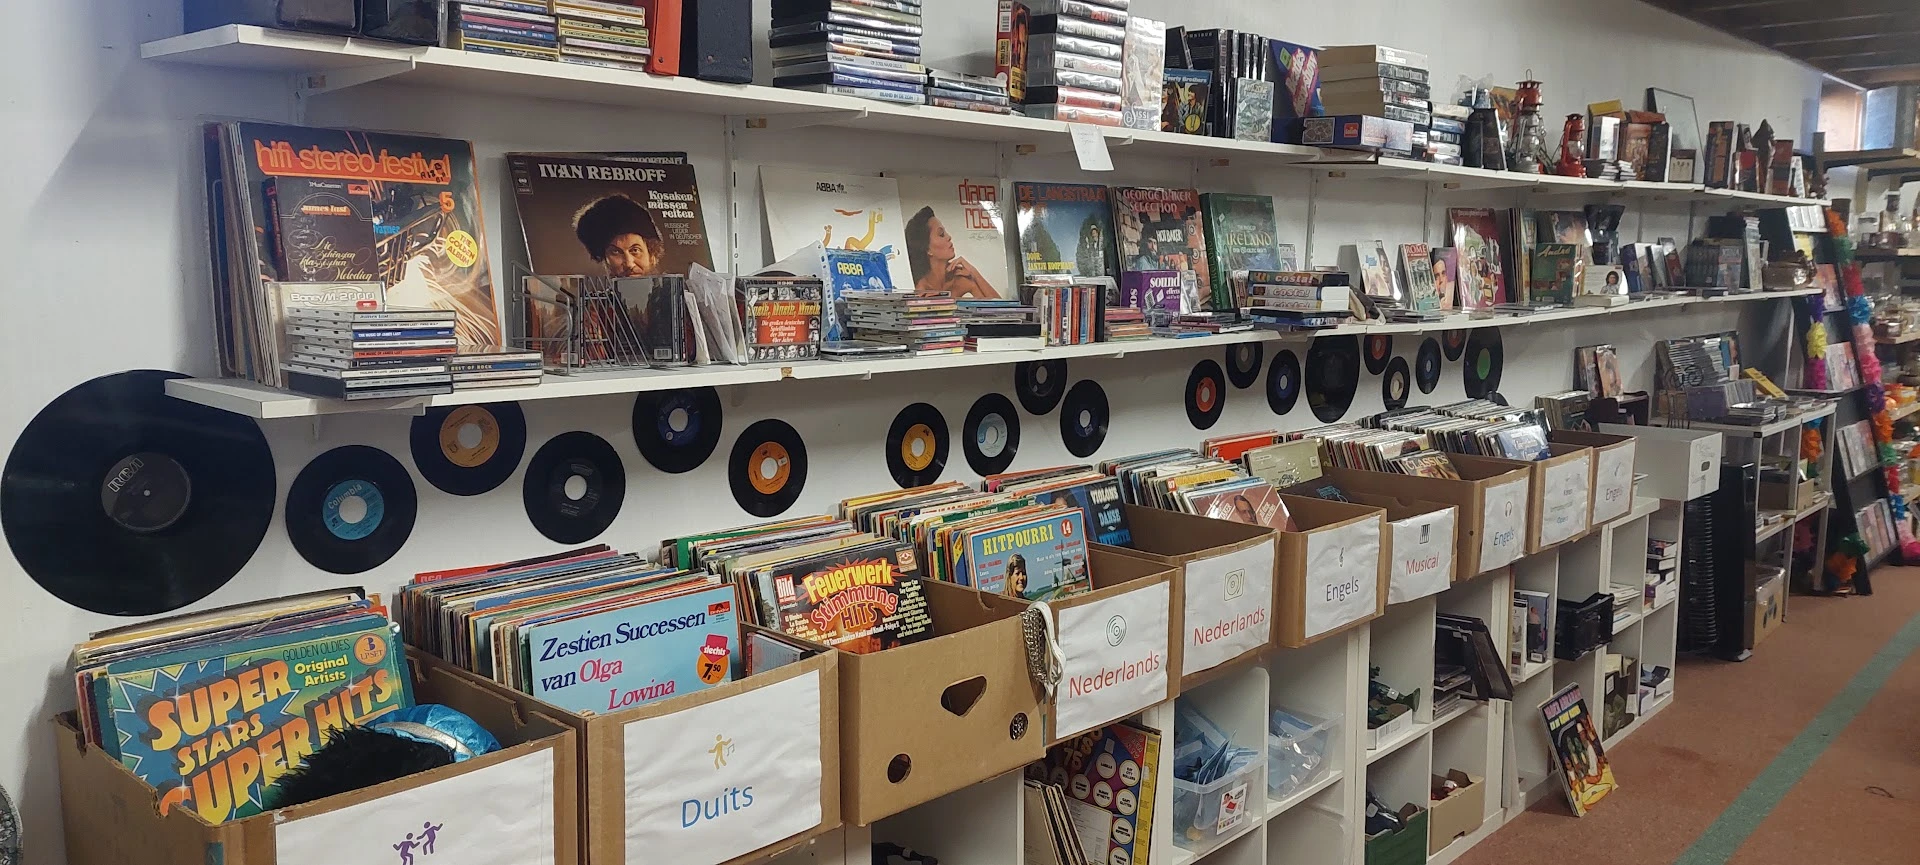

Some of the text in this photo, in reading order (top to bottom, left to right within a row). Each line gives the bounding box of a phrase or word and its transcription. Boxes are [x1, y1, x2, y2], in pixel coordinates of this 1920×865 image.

[299, 144, 376, 174] stereo
[537, 163, 584, 179] IVAN
[586, 164, 667, 182] REBROFF
[648, 189, 694, 203] Kosaken
[816, 181, 837, 193] ABBA
[958, 178, 997, 205] diana
[1017, 185, 1036, 201] DE
[1123, 188, 1192, 201] GEORGE BAKER
[440, 191, 455, 213] 5
[662, 208, 695, 219] reiten
[448, 236, 475, 260] GOLDEN
[1226, 231, 1272, 246] IRELAND
[1405, 245, 1428, 254] ROME
[446, 245, 471, 266] ALBUM
[837, 261, 865, 276] ABBA
[1149, 271, 1180, 288] sound
[1275, 275, 1314, 284] costa!
[1273, 288, 1311, 297] costa!
[107, 457, 145, 493] RCA
[327, 484, 363, 510] Columbia
[1089, 485, 1119, 505] VIOLONS
[1061, 520, 1073, 535] 14
[1098, 508, 1122, 528] DANSE
[982, 523, 1056, 557] HITPOURRI
[1493, 527, 1516, 547] Engels
[1405, 551, 1441, 576] Musical
[776, 576, 796, 599] Bild
[803, 559, 894, 604] Feuerwerk
[1326, 575, 1360, 603] Engels
[810, 584, 899, 632] Stimmung
[839, 601, 878, 631] HITS
[539, 611, 706, 663] Zestien Successen
[1193, 605, 1266, 647] Nederlands
[282, 638, 352, 662] GOLDEN OLDIES
[703, 644, 727, 656] slechts
[294, 654, 349, 674] Original
[541, 657, 624, 693] van Olga
[1069, 650, 1161, 699] Nederlands
[304, 669, 347, 687] Artists
[148, 660, 293, 752] SUPER
[607, 678, 676, 711] Lowina
[312, 669, 393, 748] HITS
[177, 712, 265, 777] STARS
[681, 785, 755, 829] Duits
